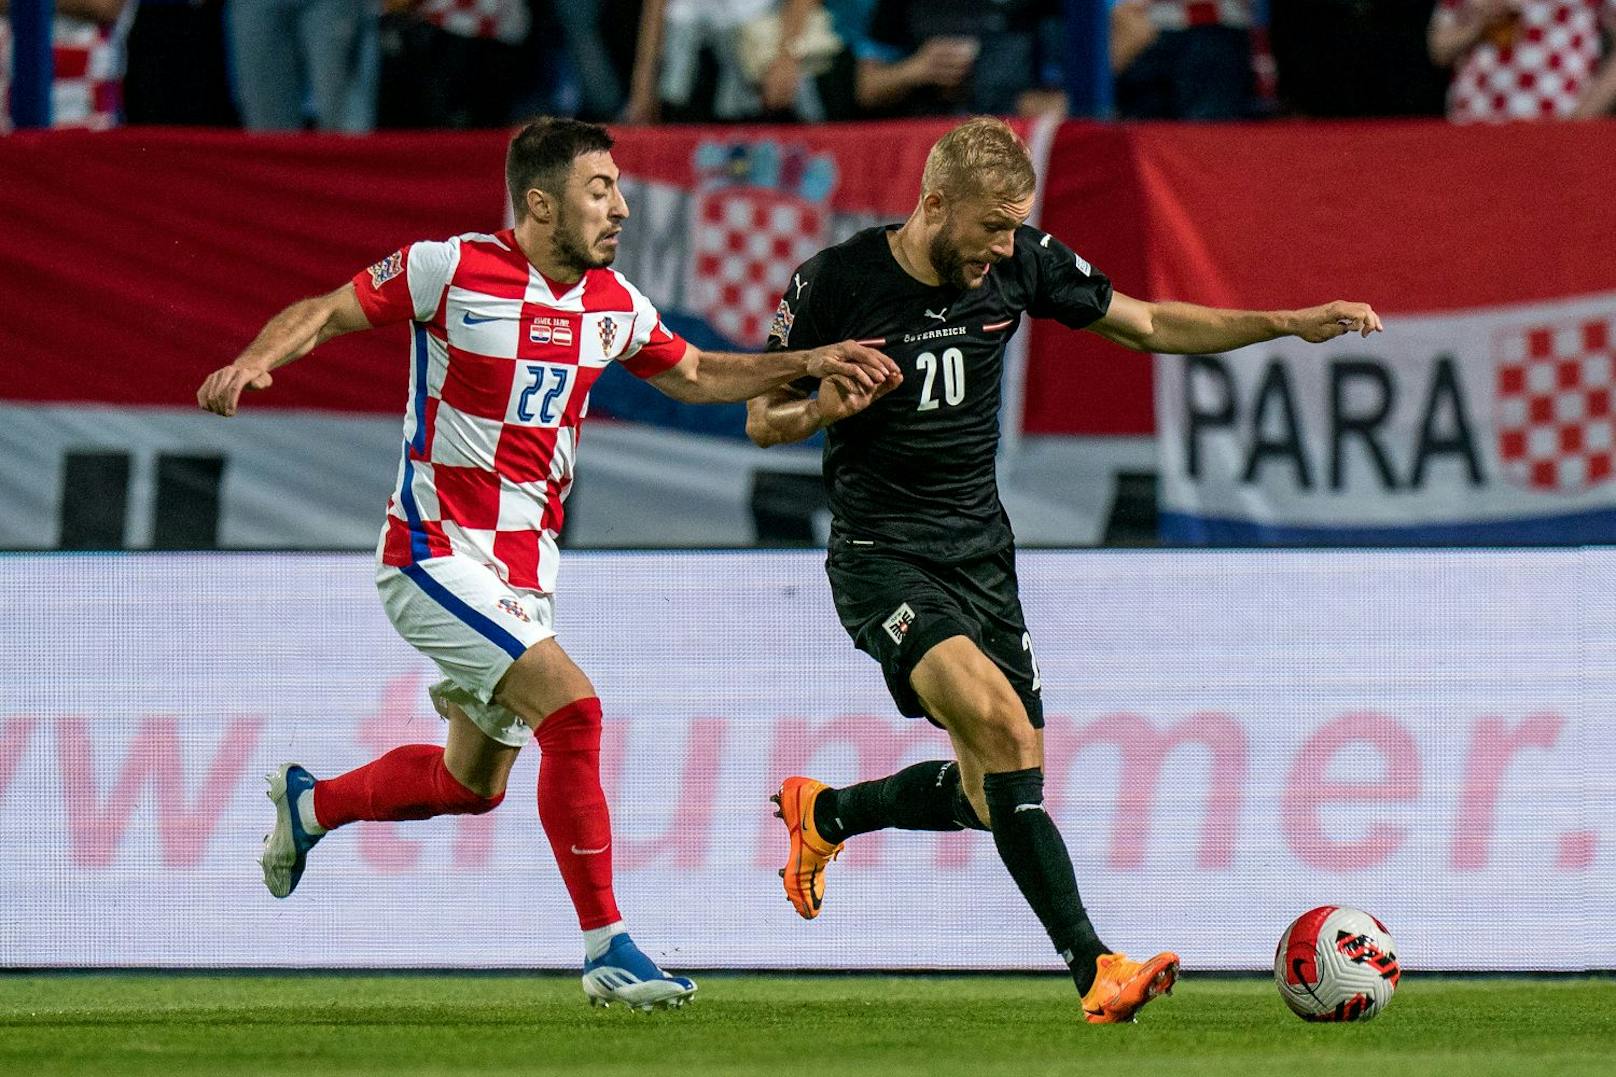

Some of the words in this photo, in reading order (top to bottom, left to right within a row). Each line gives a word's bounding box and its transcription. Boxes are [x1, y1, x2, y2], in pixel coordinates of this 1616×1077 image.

[517, 365, 568, 423] 22
[916, 347, 965, 411] 20
[1183, 354, 1487, 488] PARA
